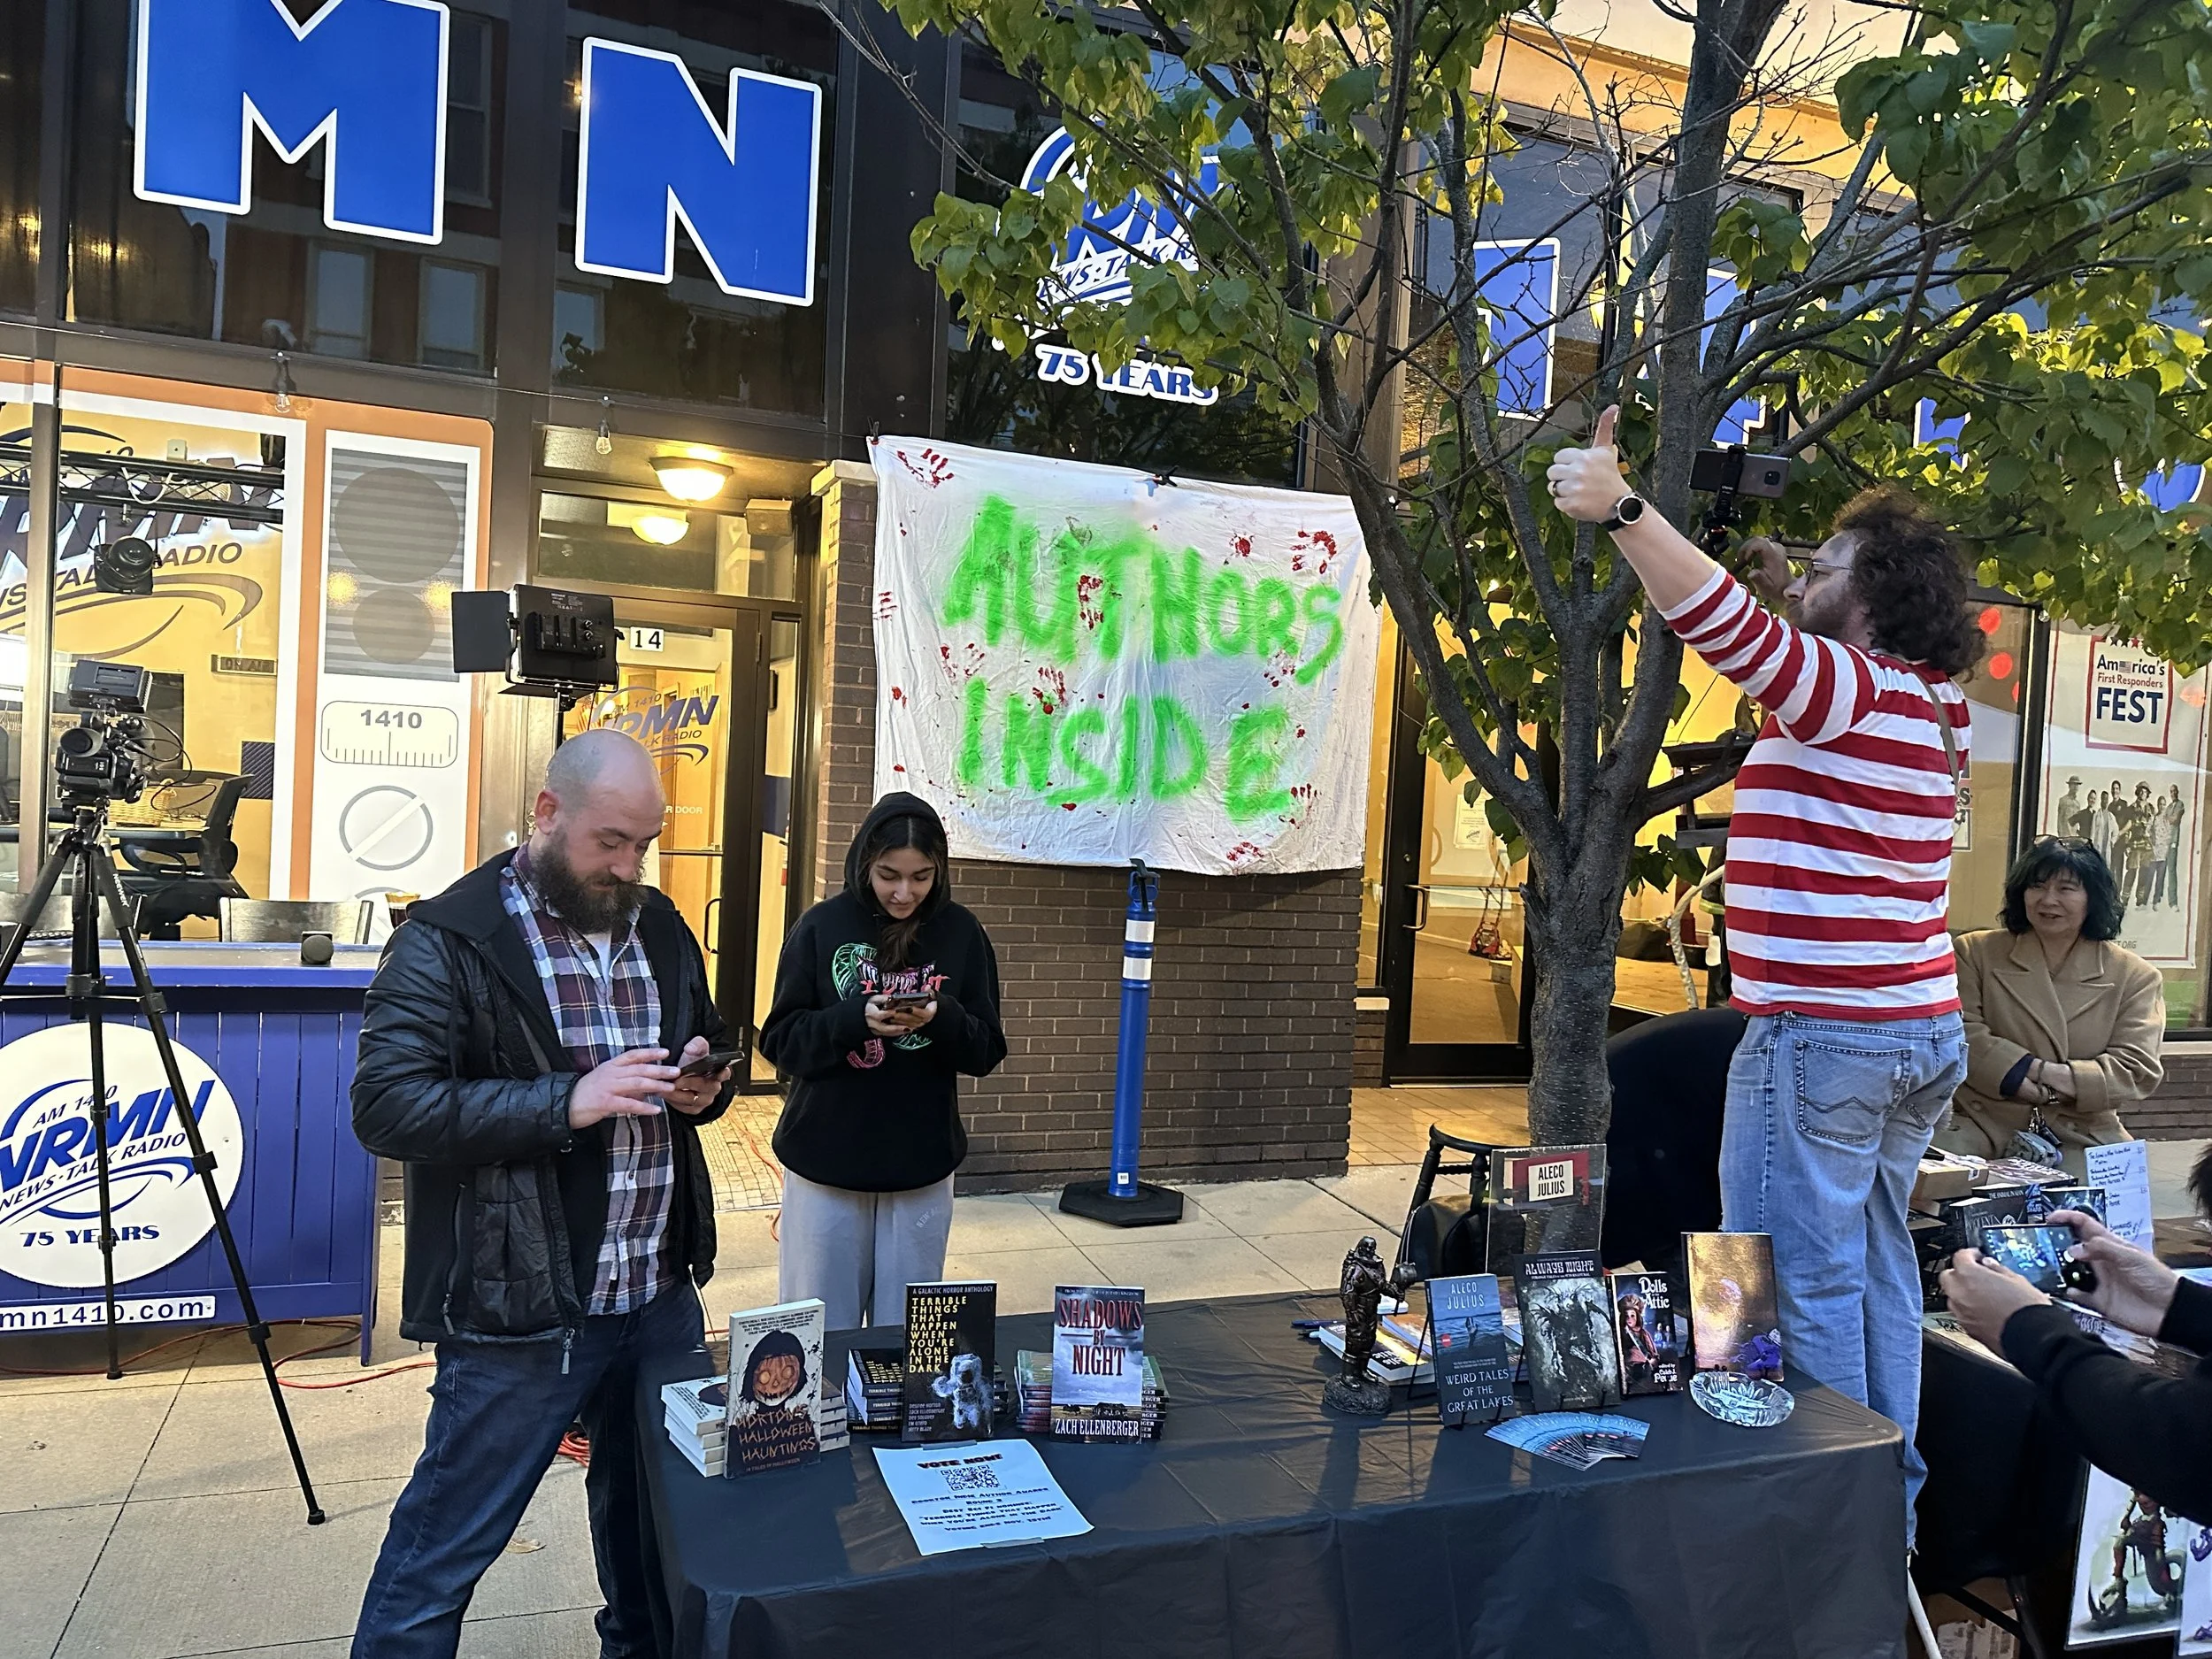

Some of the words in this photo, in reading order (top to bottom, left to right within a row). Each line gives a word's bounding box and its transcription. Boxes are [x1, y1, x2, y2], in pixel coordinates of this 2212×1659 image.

[1041, 350, 1084, 379] 75
[942, 491, 1344, 687] AUTHORS
[634, 630, 661, 649] 14
[2097, 655, 2165, 676] Amrica's
[2098, 672, 2116, 684] First
[2117, 673, 2164, 688] Responders
[2097, 687, 2164, 724] FEST
[361, 709, 422, 729] 1410
[956, 677, 1296, 829] INSIDE
[675, 806, 703, 815] DOOR
[33, 1103, 66, 1129] AM
[74, 1085, 118, 1111] 140
[120, 1133, 186, 1161] RADIO
[1538, 1164, 1564, 1180] ALECO
[1537, 1180, 1565, 1197] JULIUS
[19, 1231, 55, 1248] 75
[1525, 1261, 1564, 1275] ALWAYS
[1564, 1260, 1594, 1273] NIGHT
[1451, 1281, 1478, 1294] ALECO
[1638, 1276, 1668, 1294] Dolls
[911, 1295, 967, 1306] TERRIBLE
[911, 1304, 958, 1314] THINGS
[1447, 1294, 1485, 1310] JULIUS
[1640, 1293, 1671, 1310] Attic
[910, 1313, 942, 1323] THAT
[1058, 1298, 1142, 1330] SHADOWS
[910, 1321, 956, 1331] HAPPEN
[910, 1330, 945, 1340] WHEN
[910, 1338, 955, 1348] YOU'RE
[1093, 1329, 1106, 1346] BY
[909, 1347, 949, 1356] ALONE
[909, 1356, 922, 1365] IN
[926, 1355, 949, 1364] THE
[909, 1363, 941, 1373] DARK
[1071, 1344, 1126, 1377] NIGHT
[1445, 1374, 1477, 1386] WEIRD
[1479, 1368, 1509, 1380] TALES
[1463, 1387, 1473, 1396] OF
[1477, 1386, 1494, 1395] THE
[1448, 1400, 1479, 1413] GREAT
[1483, 1394, 1514, 1409] LAKES
[738, 1421, 814, 1447] HALLOWEEN
[1055, 1418, 1079, 1436] ZACH
[1079, 1419, 1140, 1437] ELLENBERGER
[741, 1436, 817, 1464] HAUNTINGS
[917, 1459, 960, 1470] VOTE
[963, 1453, 1003, 1464] NOW!
